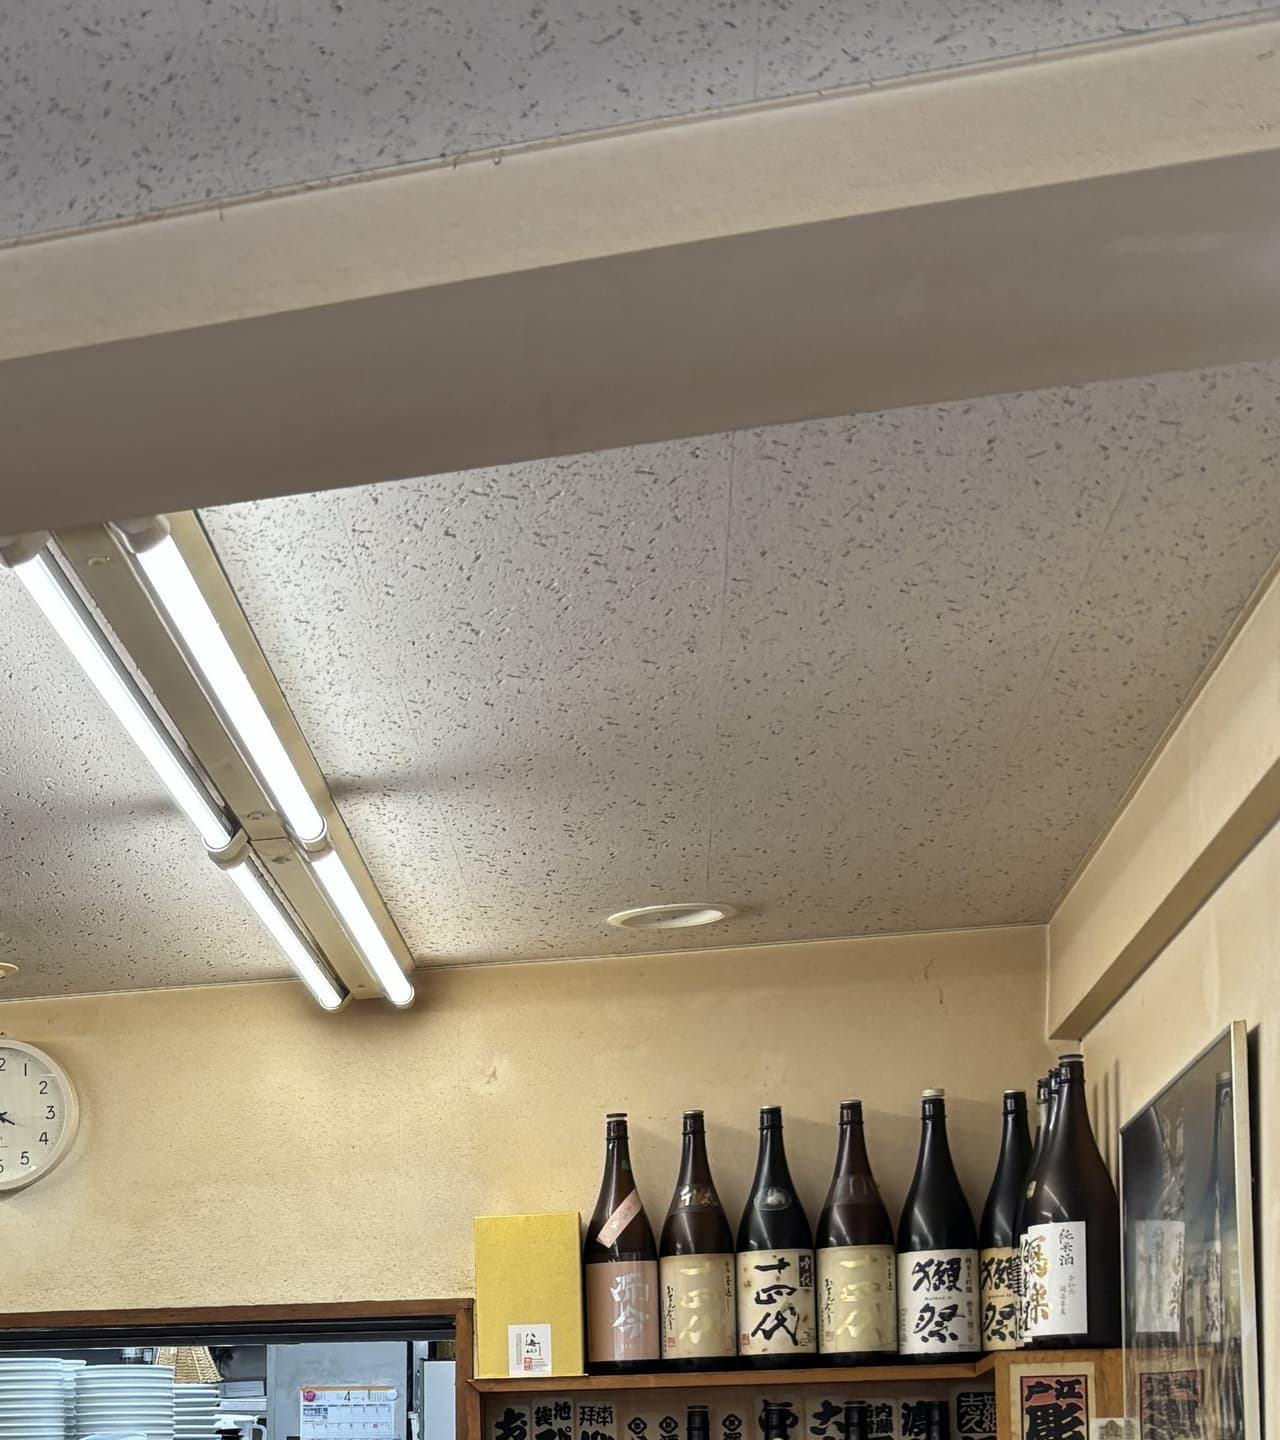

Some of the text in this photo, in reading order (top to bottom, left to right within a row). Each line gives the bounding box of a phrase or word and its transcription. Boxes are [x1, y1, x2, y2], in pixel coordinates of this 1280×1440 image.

[23, 1063, 27, 1076] 1
[39, 1080, 48, 1095] 2
[45, 1105, 55, 1119] 3
[38, 1132, 48, 1145] 4
[20, 1151, 30, 1165] 5
[751, 1257, 800, 1347] 十四代
[912, 1257, 966, 1343] 獺祭
